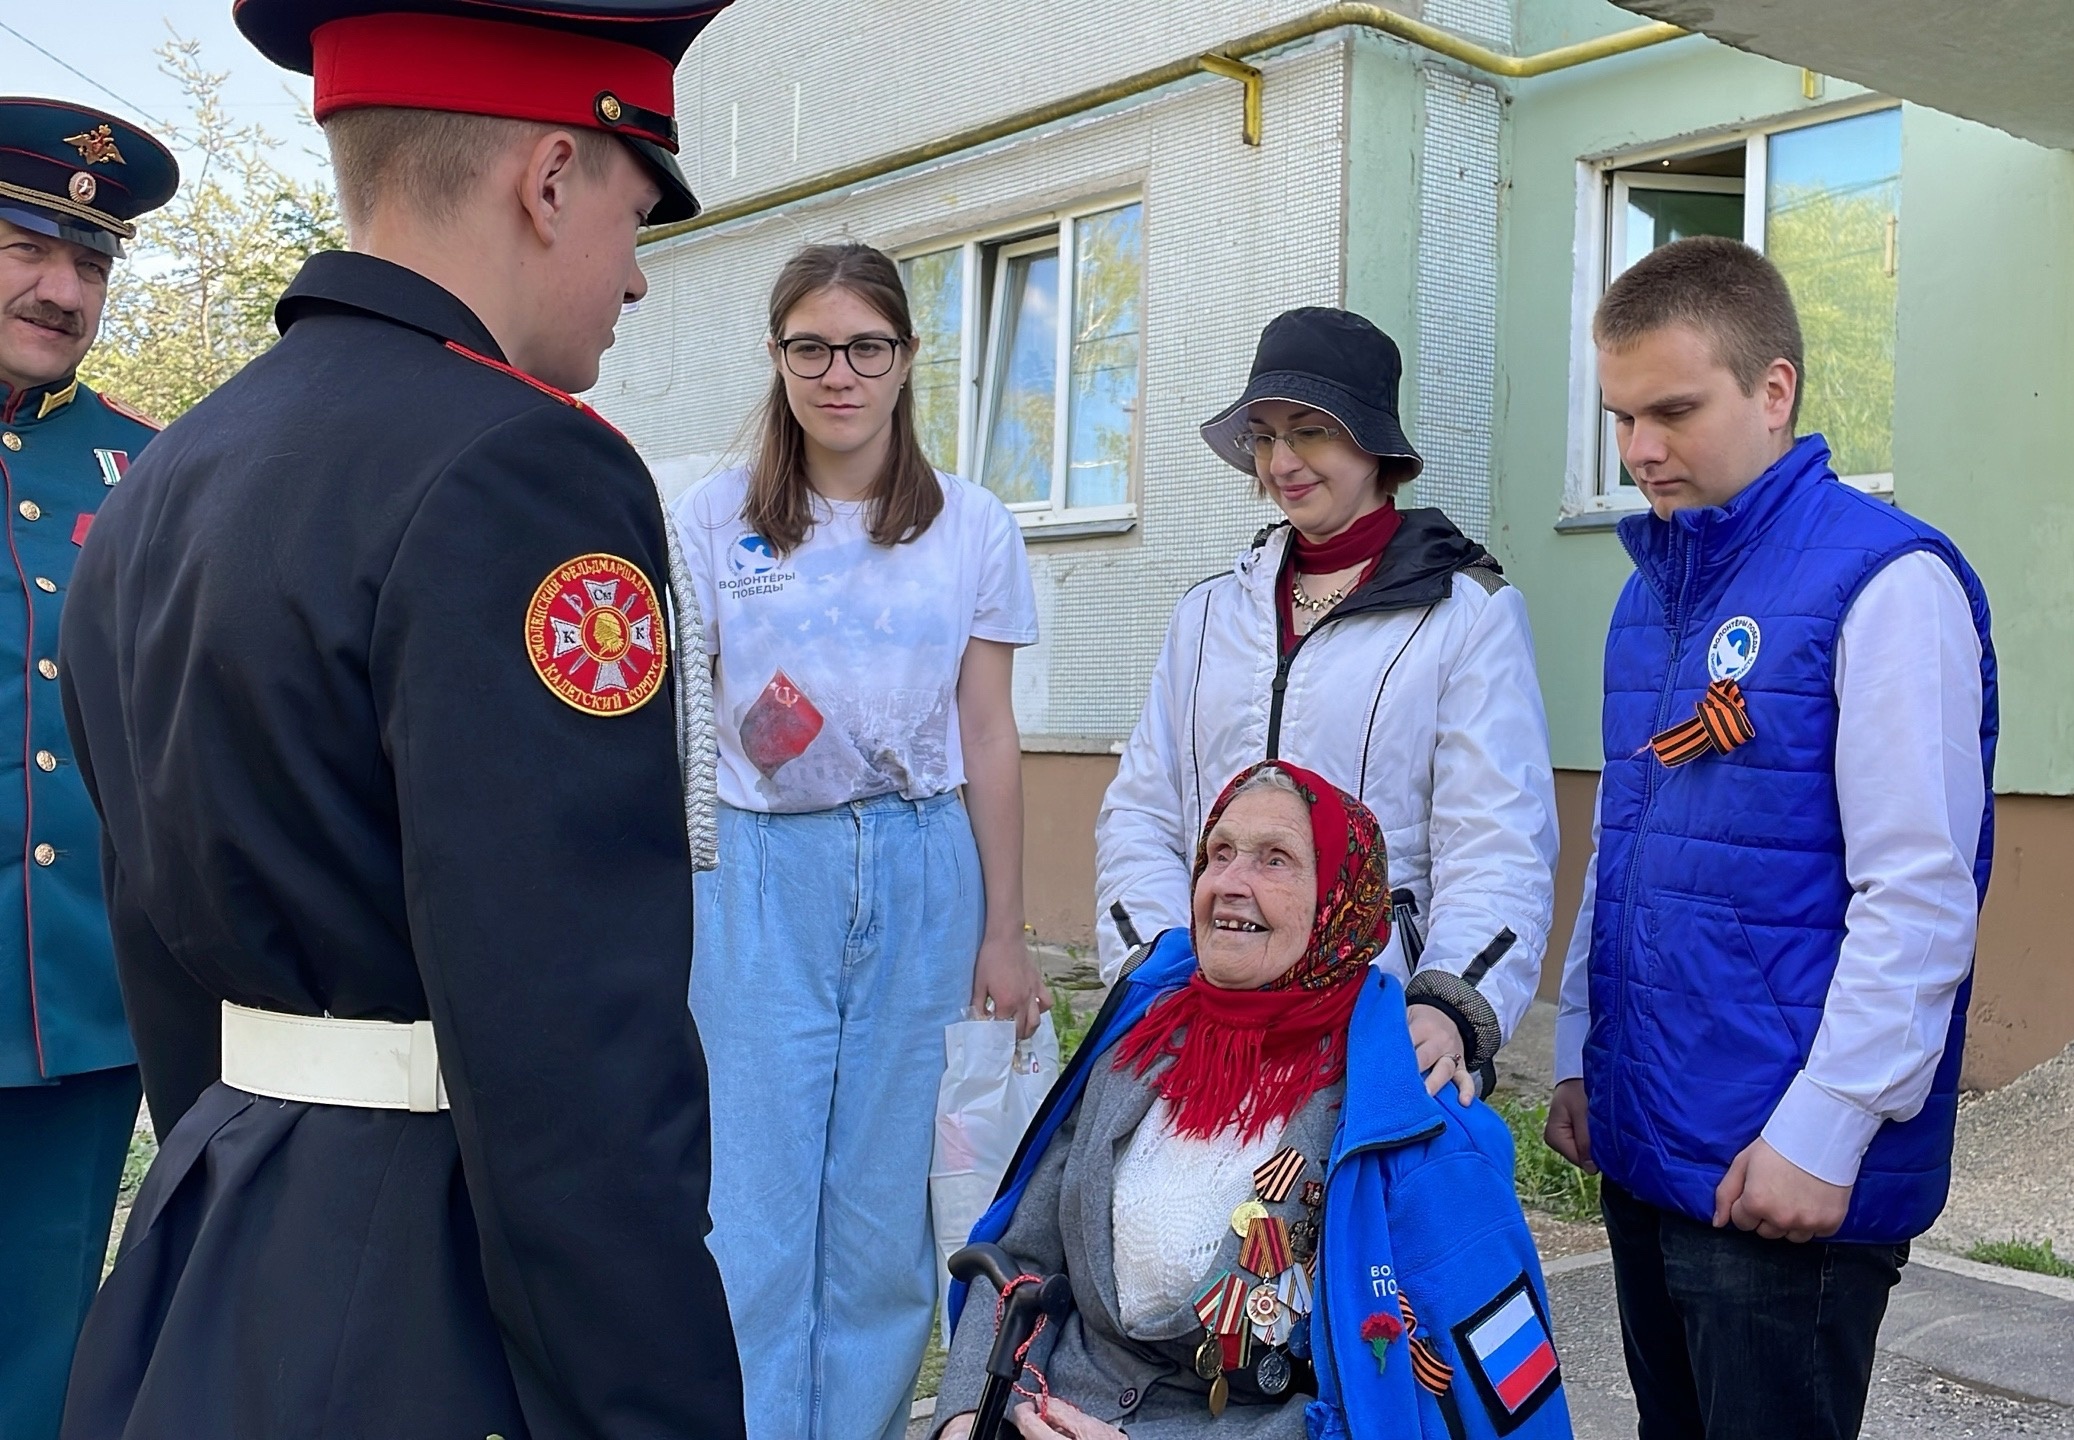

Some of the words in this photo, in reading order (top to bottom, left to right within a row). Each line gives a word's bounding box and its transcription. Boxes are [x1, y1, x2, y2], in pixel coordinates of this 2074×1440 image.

[718, 572, 796, 589] ВОЛОНТЁРЫ
[732, 583, 784, 599] ПОБЕДЫ
[543, 662, 622, 711] КАДЕТСКИЙ
[625, 658, 661, 705] КОРПУС
[1370, 1264, 1395, 1278] ВО
